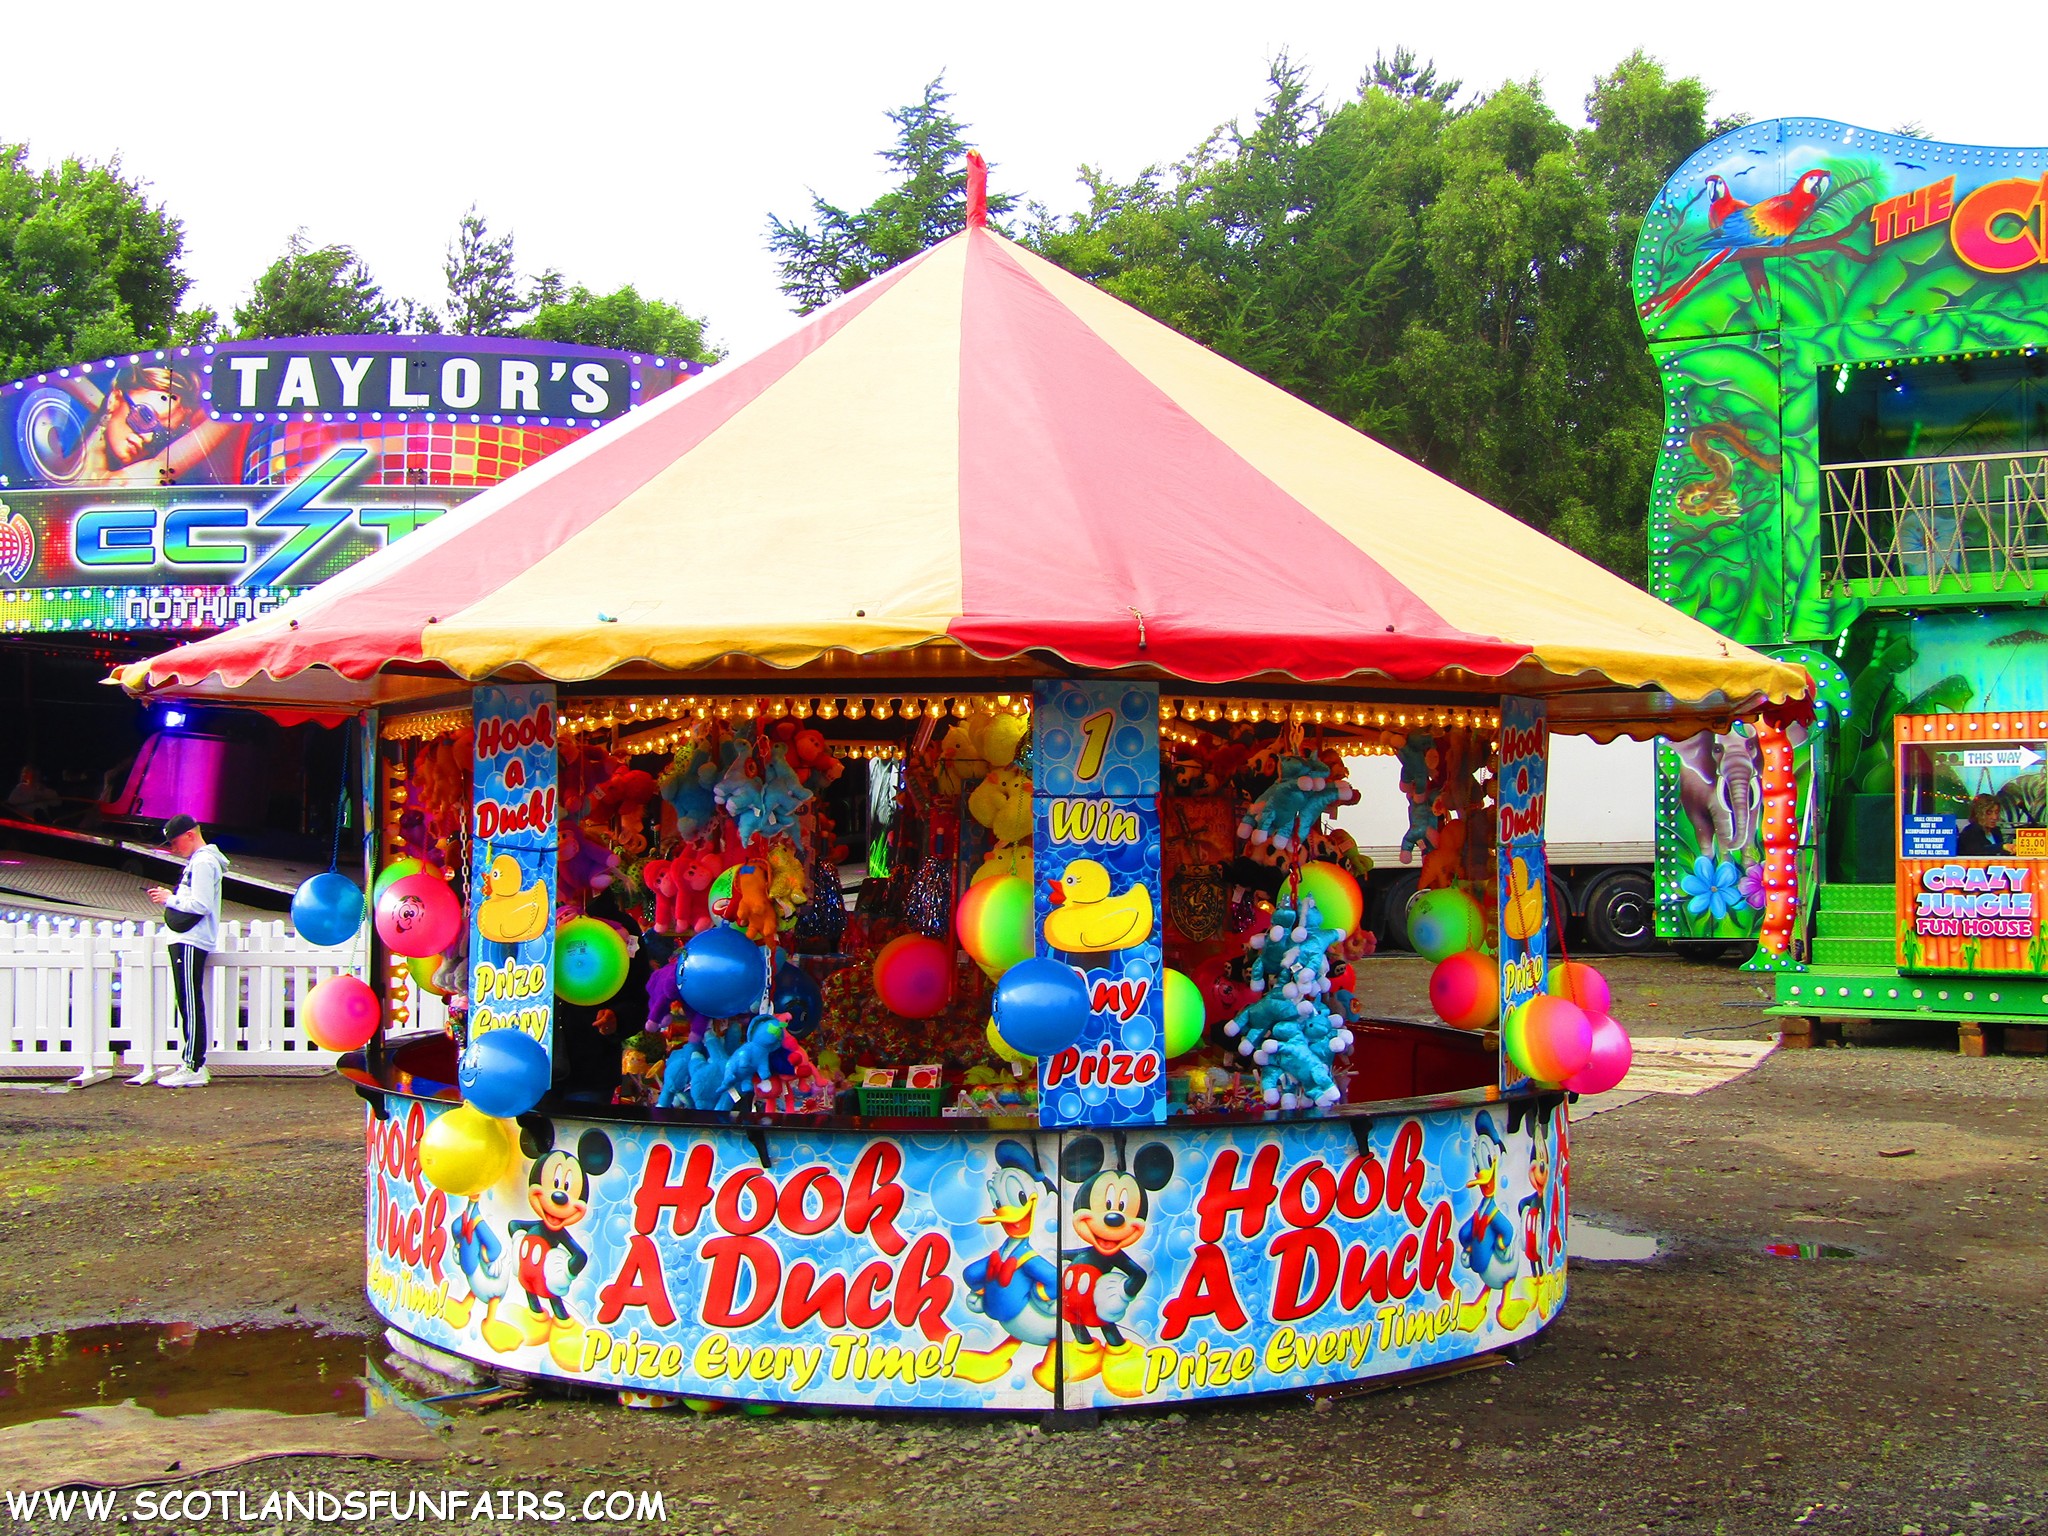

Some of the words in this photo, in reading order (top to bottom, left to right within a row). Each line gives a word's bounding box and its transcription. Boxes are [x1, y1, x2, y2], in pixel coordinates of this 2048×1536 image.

[1870, 173, 1957, 246] THE
[230, 355, 610, 414] TAYLOR'S
[477, 704, 555, 760] Hook
[1076, 711, 1114, 781] 1
[1502, 718, 1544, 765] Hook
[504, 760, 525, 789] a
[1516, 767, 1528, 795] a
[1967, 752, 1994, 765] THIS
[1997, 751, 2022, 764] WAY
[476, 787, 556, 839] Duck!
[1052, 800, 1137, 842] Win
[1500, 793, 1544, 843] Duck!
[2020, 838, 2045, 847] £3.00
[1923, 865, 2029, 891] CRAZY
[1916, 893, 2032, 918] JUNGLE
[1916, 918, 1958, 935] FUN
[1962, 919, 2032, 937] HOUSE
[475, 960, 545, 1003] Prize
[1076, 971, 1147, 1021] ny
[1047, 1043, 1156, 1086] Prize
[633, 1141, 905, 1256] Hook
[1197, 1120, 1427, 1245] Hook
[376, 1173, 447, 1286] Duck
[598, 1235, 676, 1328] A
[701, 1232, 954, 1343] Duck
[1160, 1243, 1248, 1341] A
[1270, 1202, 1456, 1322] Duck
[583, 1330, 681, 1377] Prize
[694, 1334, 821, 1390] Every
[832, 1333, 963, 1384] Time!
[1145, 1347, 1255, 1394] Prize
[1266, 1325, 1371, 1375] Every
[1379, 1289, 1462, 1351] Time!
